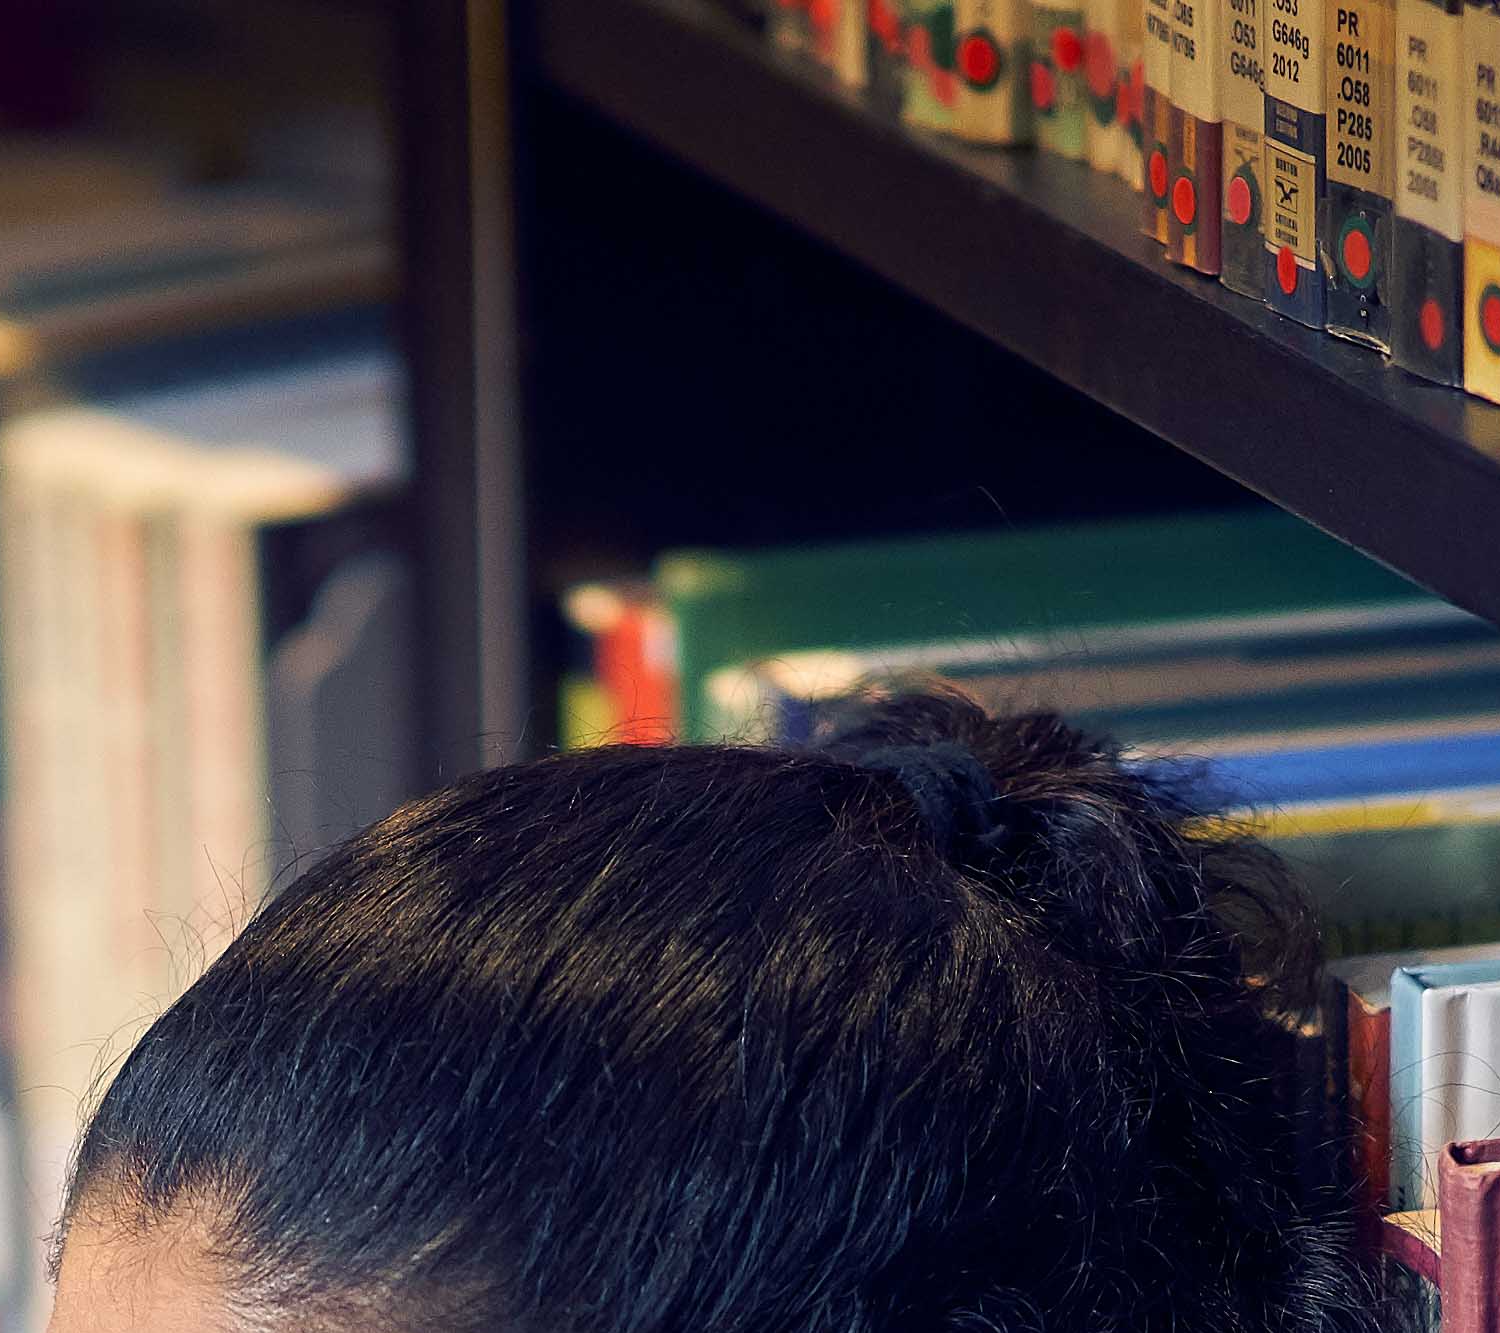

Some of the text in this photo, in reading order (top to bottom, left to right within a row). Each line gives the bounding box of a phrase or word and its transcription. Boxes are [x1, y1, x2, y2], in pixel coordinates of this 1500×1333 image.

[1337, 9, 1359, 37] PR
[1272, 19, 1309, 60] G646g
[1272, 52, 1300, 83] 2012
[1336, 42, 1370, 75] 6011
[1337, 76, 1370, 107] .O58
[1337, 108, 1373, 141] P285
[1337, 142, 1371, 174] 2005
